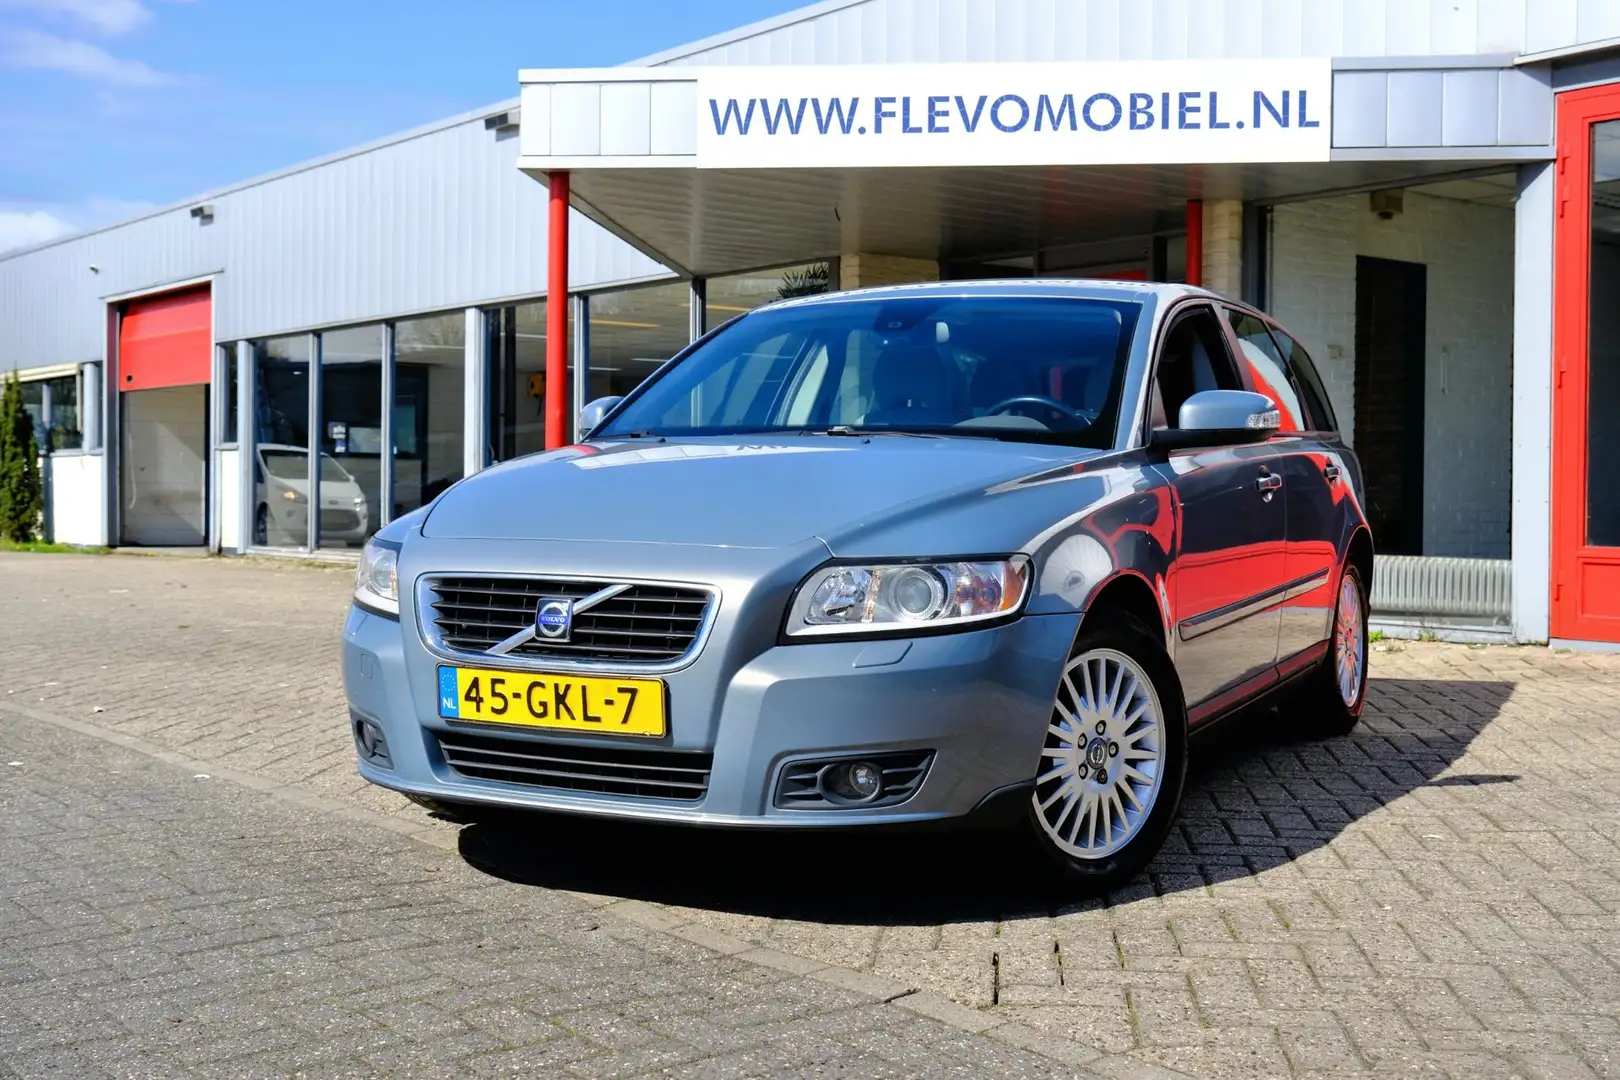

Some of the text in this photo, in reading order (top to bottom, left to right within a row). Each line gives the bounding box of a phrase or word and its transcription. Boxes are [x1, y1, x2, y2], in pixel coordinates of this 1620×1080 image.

[708, 89, 1321, 136] WWW.FLEVOMOBIEL.NL
[442, 697, 457, 710] NL
[464, 676, 639, 725] 45-GKL-7
